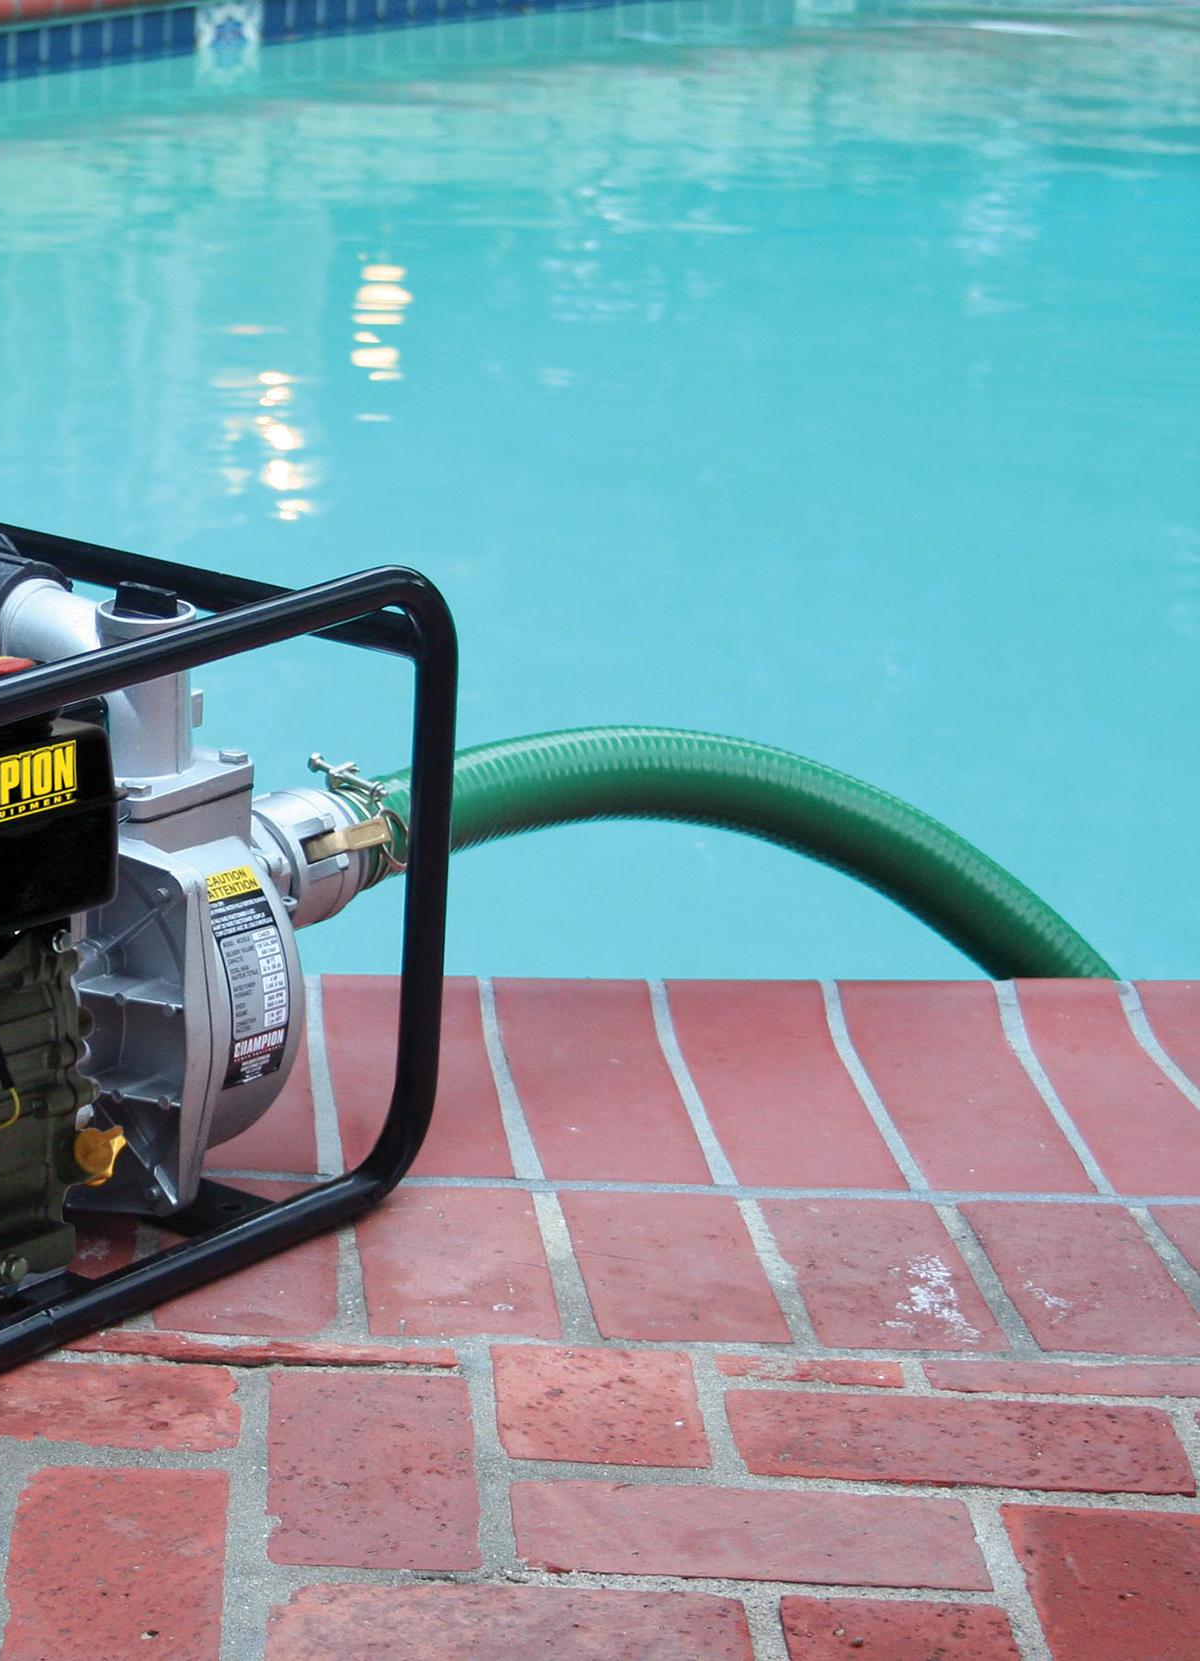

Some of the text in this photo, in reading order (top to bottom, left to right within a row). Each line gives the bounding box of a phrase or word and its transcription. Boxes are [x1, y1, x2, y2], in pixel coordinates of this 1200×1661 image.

[207, 868, 247, 888] CAUTION
[207, 878, 258, 900] ATTENTION
[234, 1029, 284, 1058] CHAMPION
